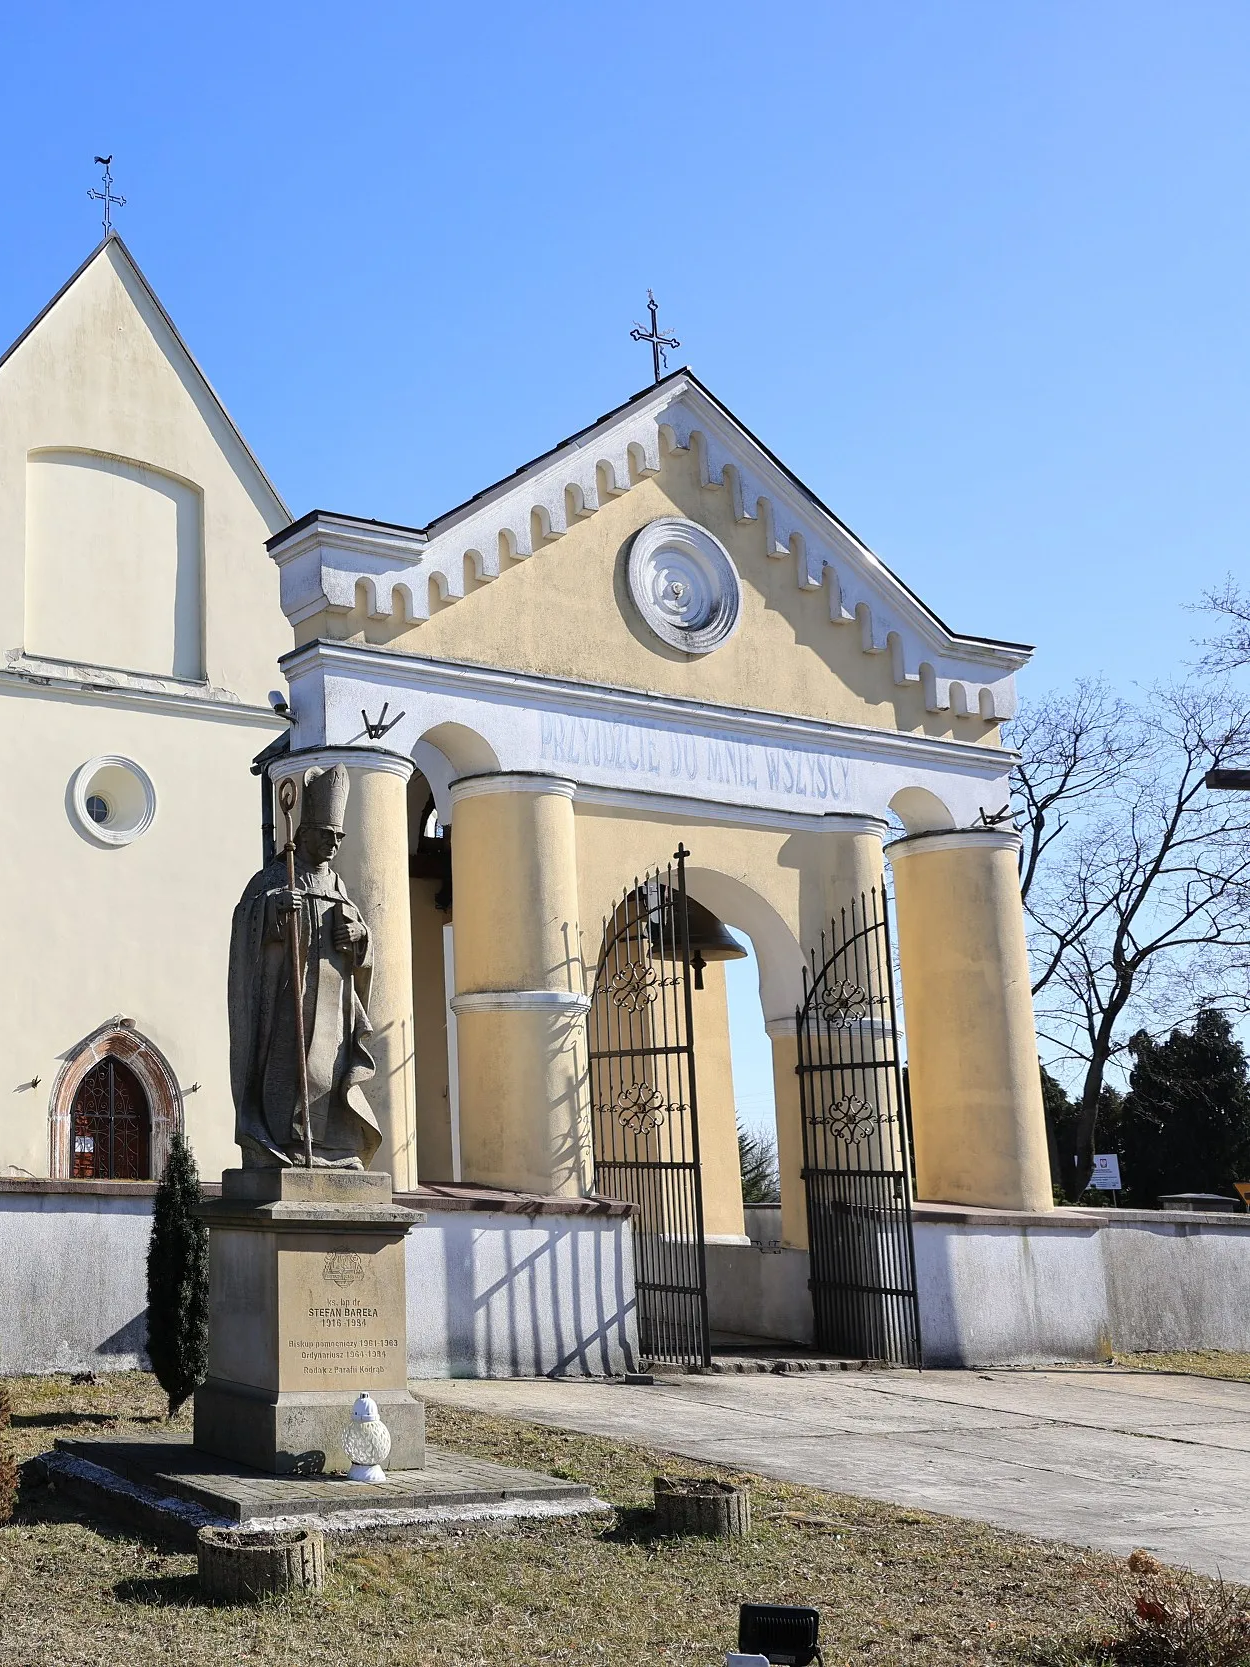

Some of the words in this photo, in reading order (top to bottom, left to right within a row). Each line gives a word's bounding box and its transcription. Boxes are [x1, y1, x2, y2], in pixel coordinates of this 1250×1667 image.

[668, 726, 698, 781] DO
[706, 732, 758, 791] MNIE
[762, 740, 852, 802] WSZYSCY
[340, 1297, 350, 1308] bp
[352, 1297, 361, 1307] dr
[308, 1307, 342, 1318] STEFAN
[288, 1340, 314, 1349] Biskup
[301, 1351, 344, 1360] Ordynariusz
[303, 1366, 327, 1374] Rodak
